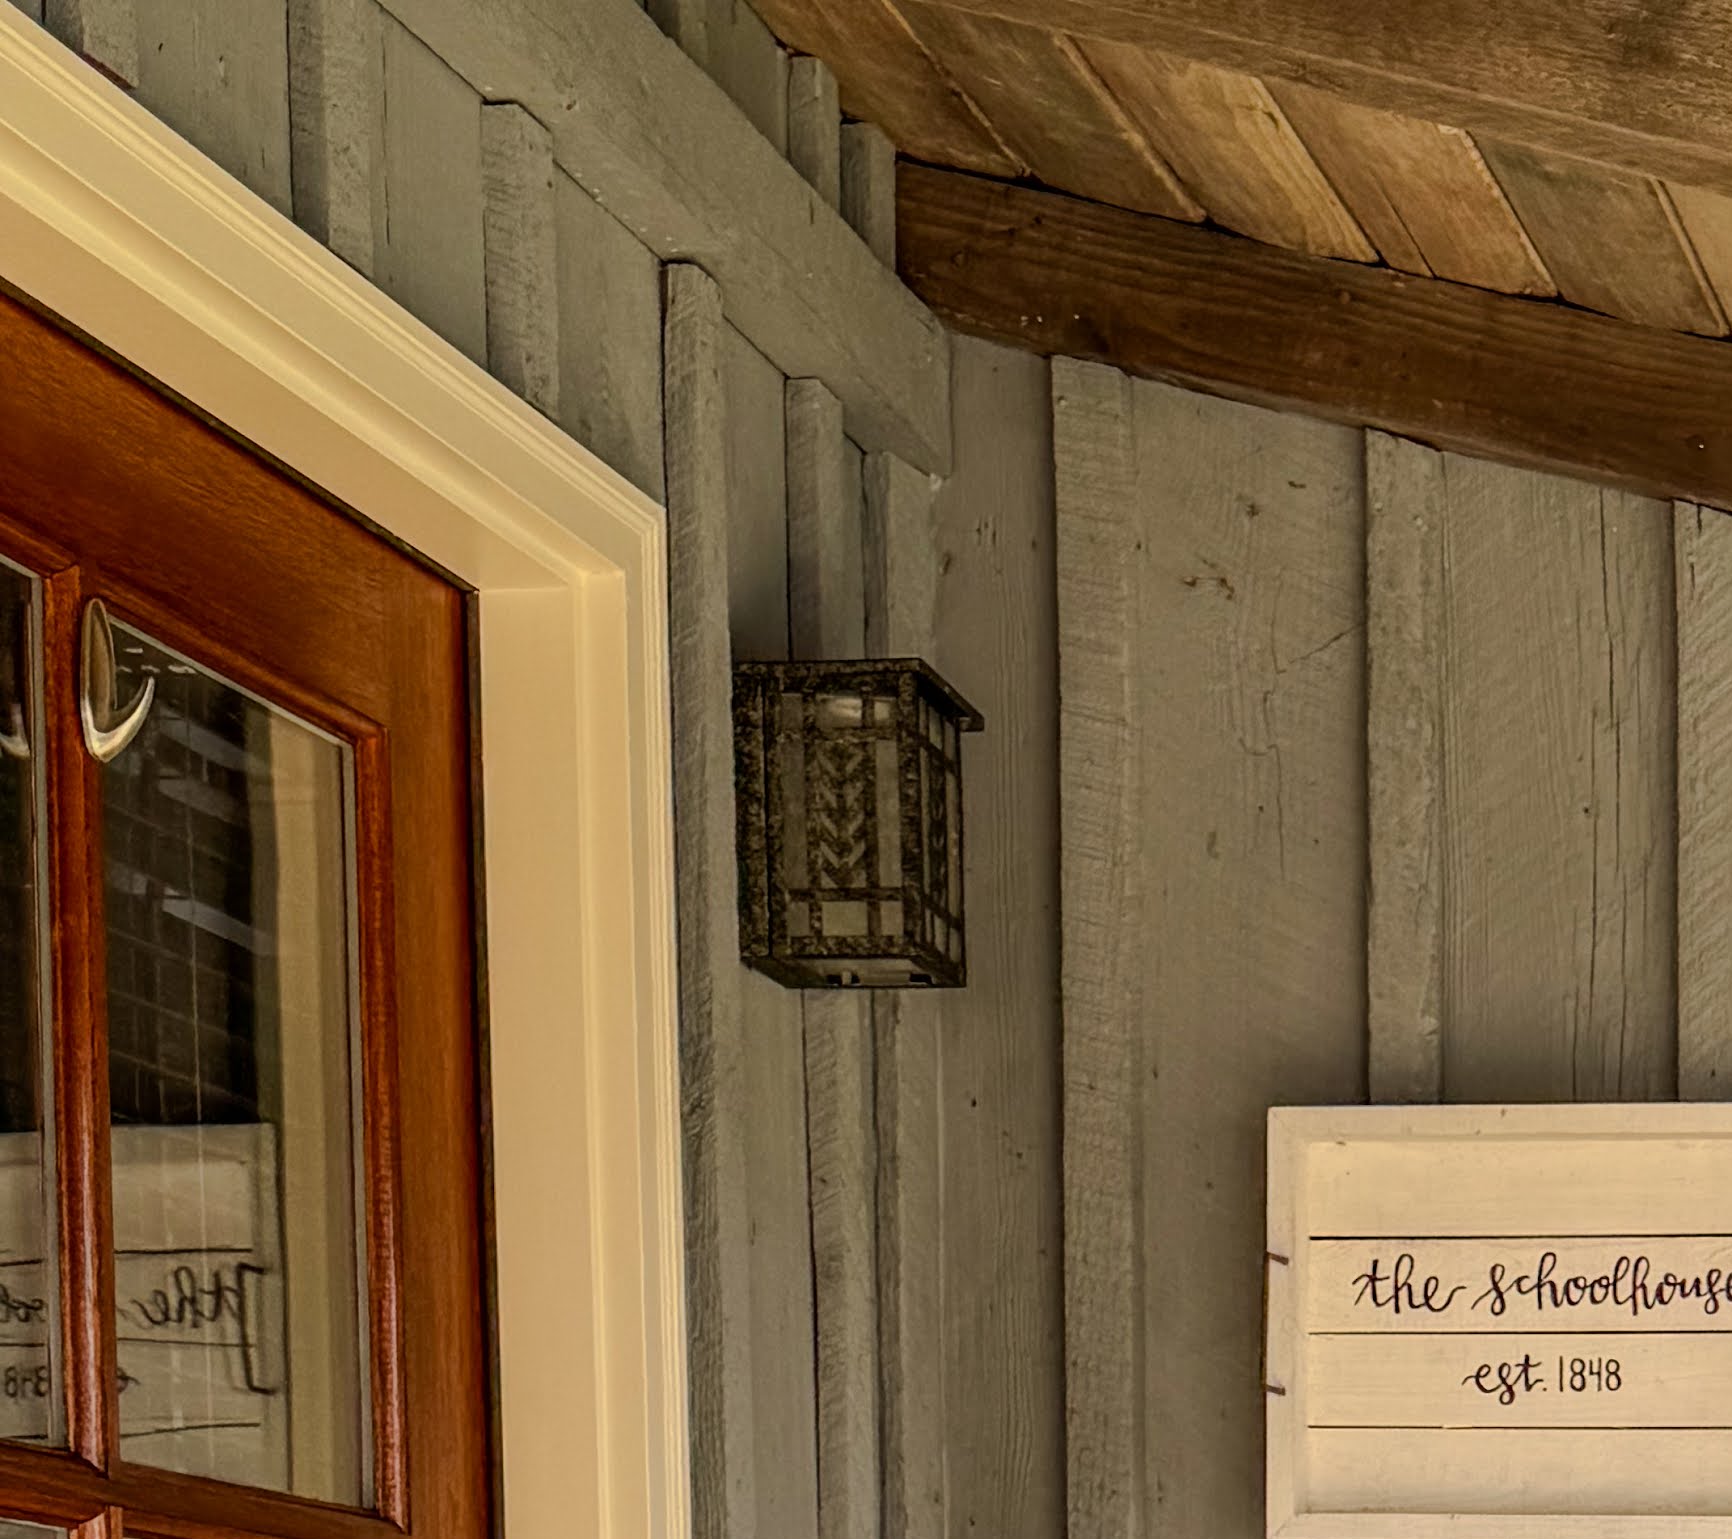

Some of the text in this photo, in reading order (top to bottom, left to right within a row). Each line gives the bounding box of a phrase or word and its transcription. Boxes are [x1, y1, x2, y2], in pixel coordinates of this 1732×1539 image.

[1352, 1253, 1467, 1315] the
[1461, 1354, 1622, 1405] est. 1848
